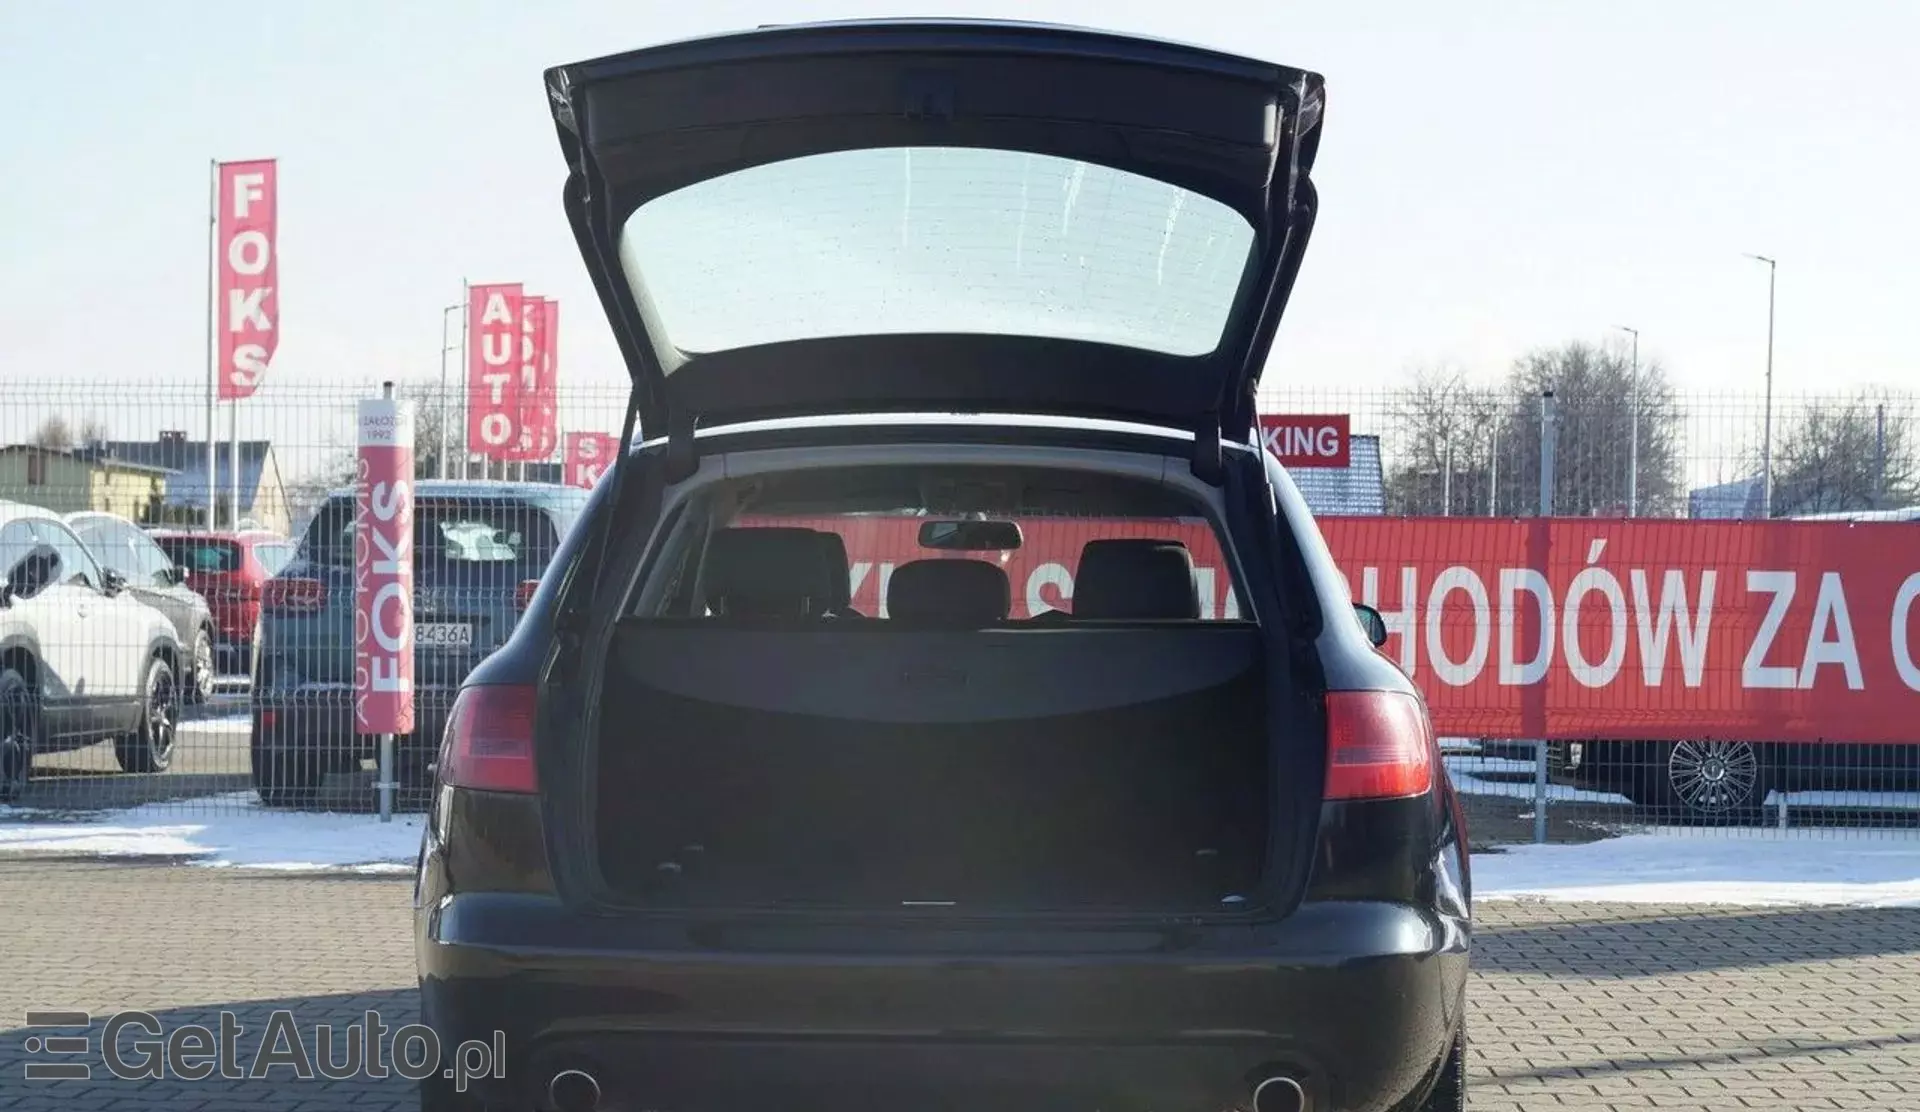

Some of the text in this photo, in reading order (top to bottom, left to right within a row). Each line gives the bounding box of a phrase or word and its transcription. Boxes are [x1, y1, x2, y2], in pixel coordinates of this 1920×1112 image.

[228, 172, 272, 388] FOKS
[367, 429, 391, 440] 1992
[480, 292, 513, 446] AUTO
[372, 479, 411, 693] FOKS
[1741, 570, 1865, 691] ZA
